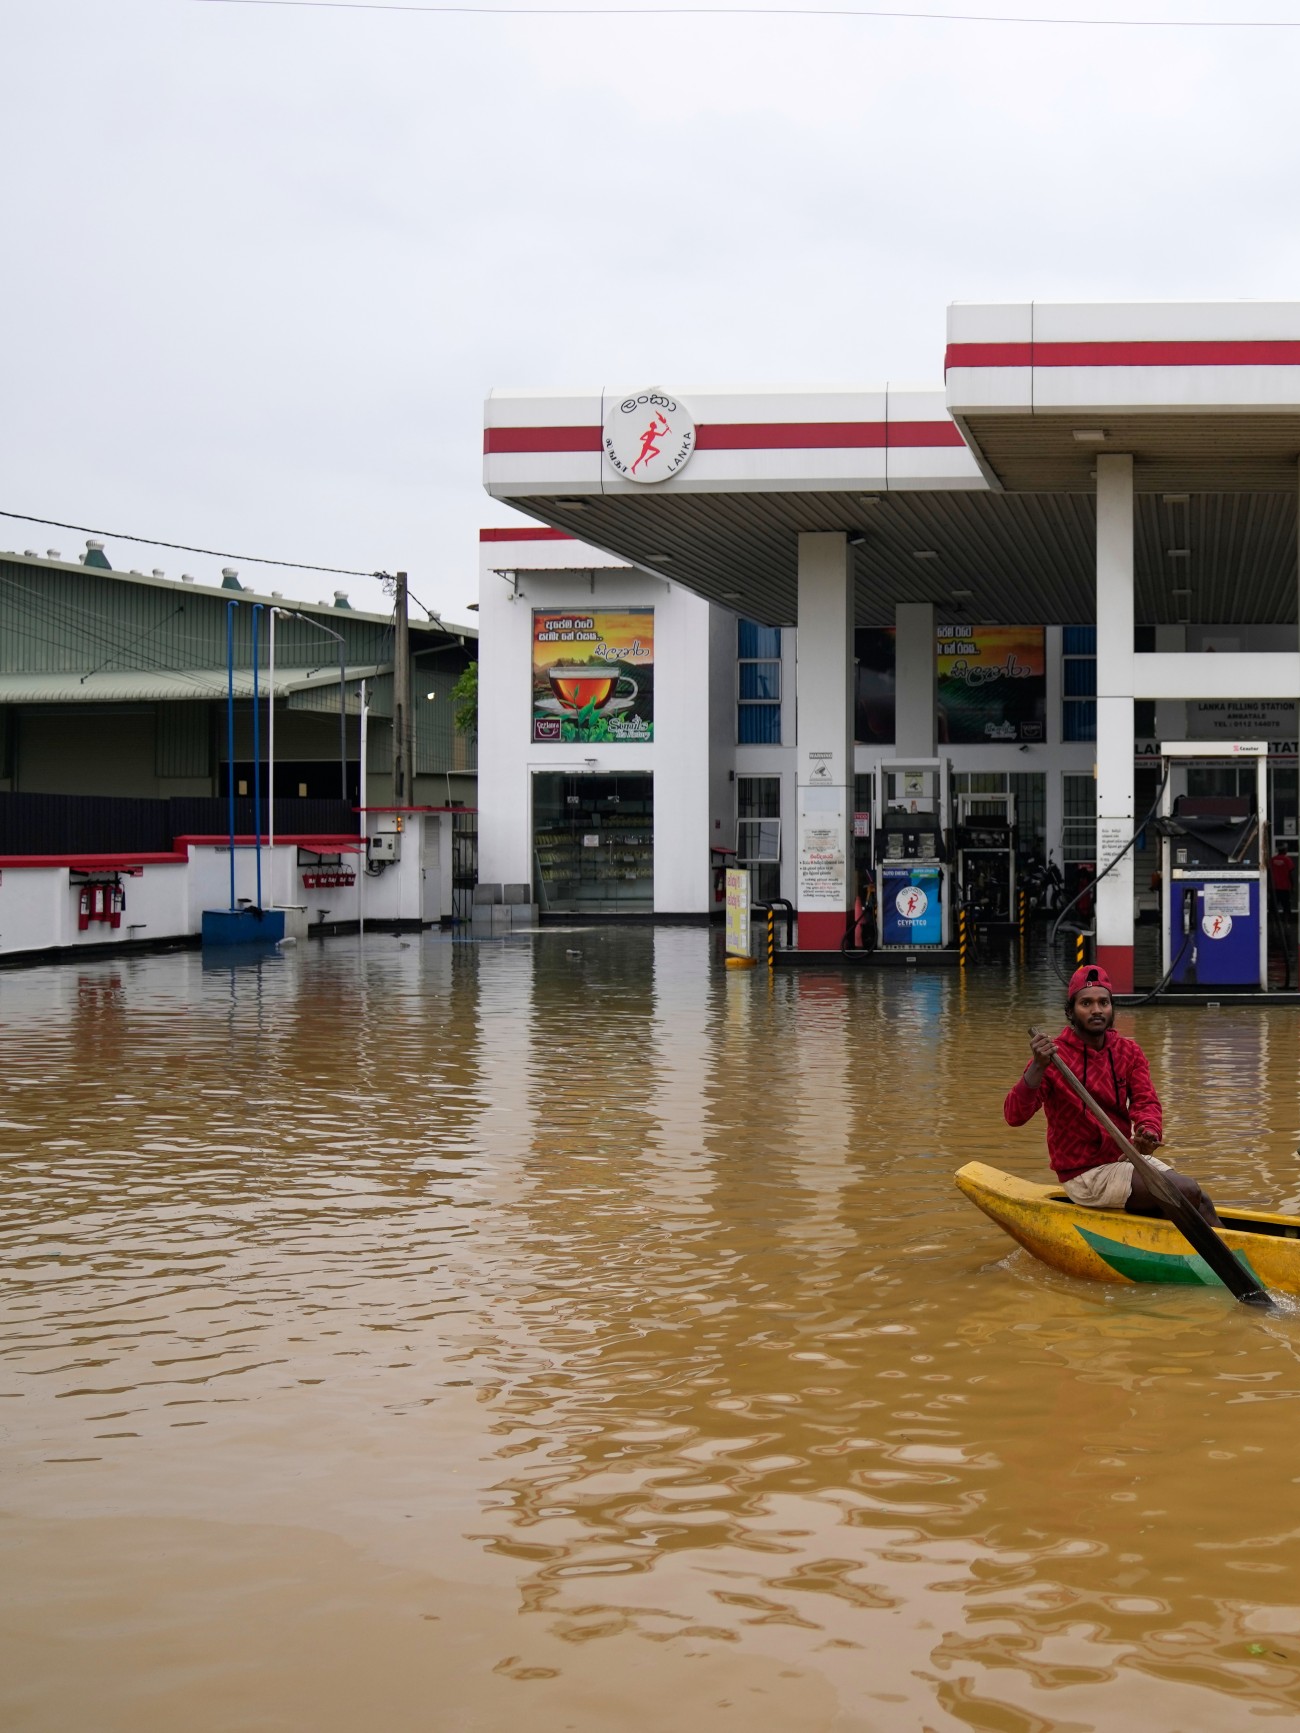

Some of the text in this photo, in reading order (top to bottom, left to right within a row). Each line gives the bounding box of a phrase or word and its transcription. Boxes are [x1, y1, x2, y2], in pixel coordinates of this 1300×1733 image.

[620, 394, 677, 413] ලංකා
[667, 432, 691, 472] LANKA
[1198, 702, 1295, 711] LANKA FILLING STATION
